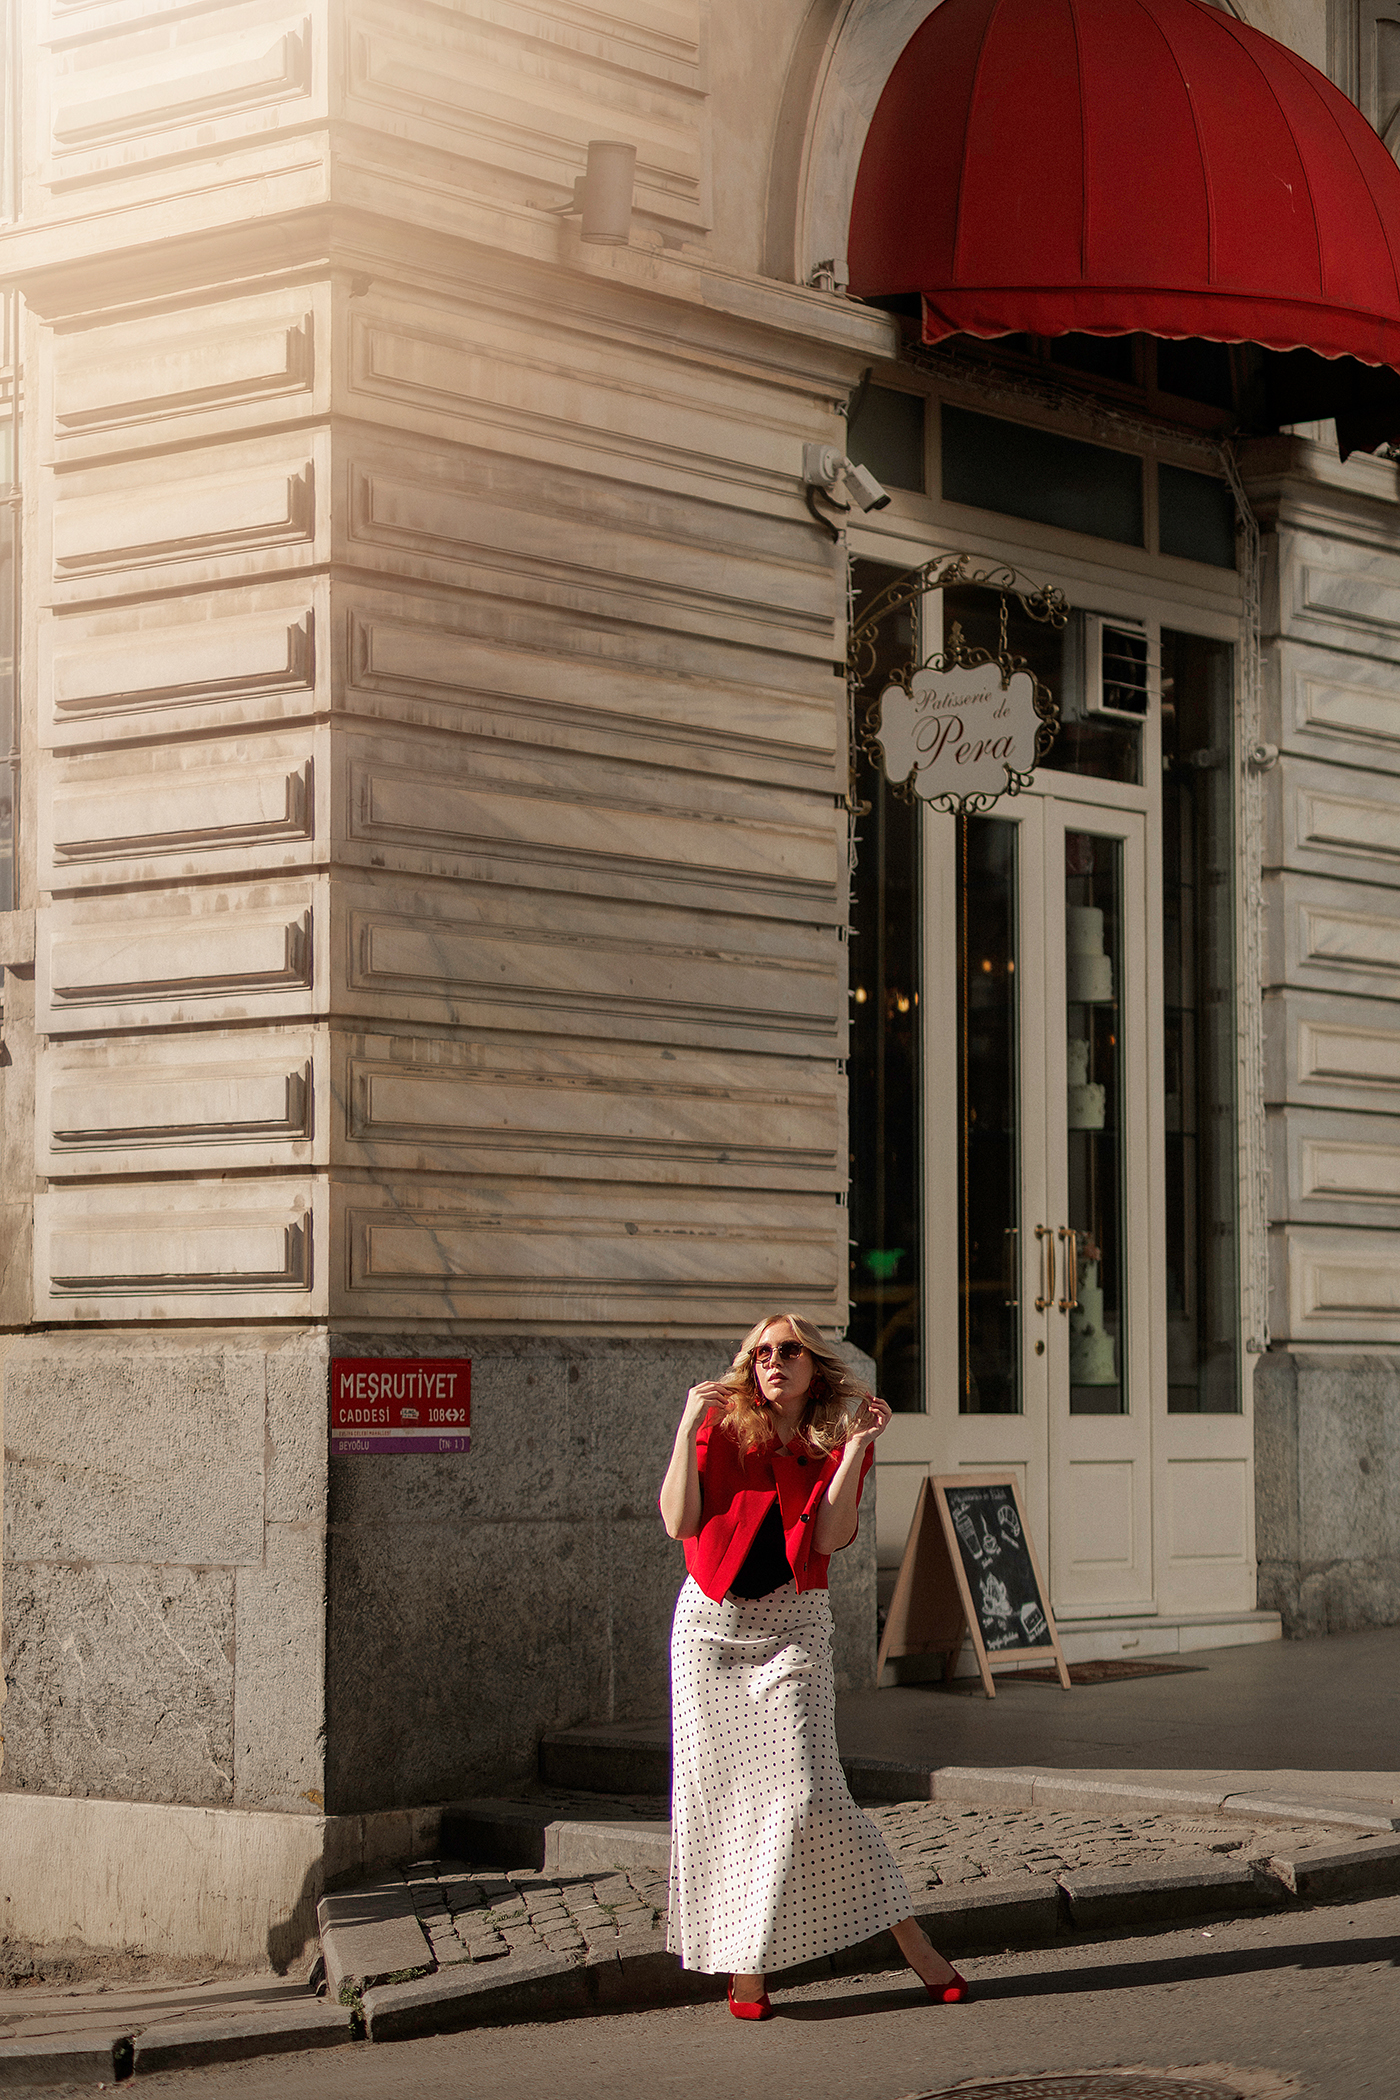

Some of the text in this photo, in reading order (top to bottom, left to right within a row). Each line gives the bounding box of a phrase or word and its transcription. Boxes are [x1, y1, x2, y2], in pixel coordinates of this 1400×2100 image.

[915, 687, 993, 713] Patisserie
[993, 698, 1010, 719] de
[911, 714, 1016, 771] Pera
[340, 1369, 458, 1404] MEŞRUTİYET
[339, 1406, 390, 1423] CADDESİ
[429, 1408, 445, 1422] 108
[338, 1439, 370, 1451] BEYOĞLU
